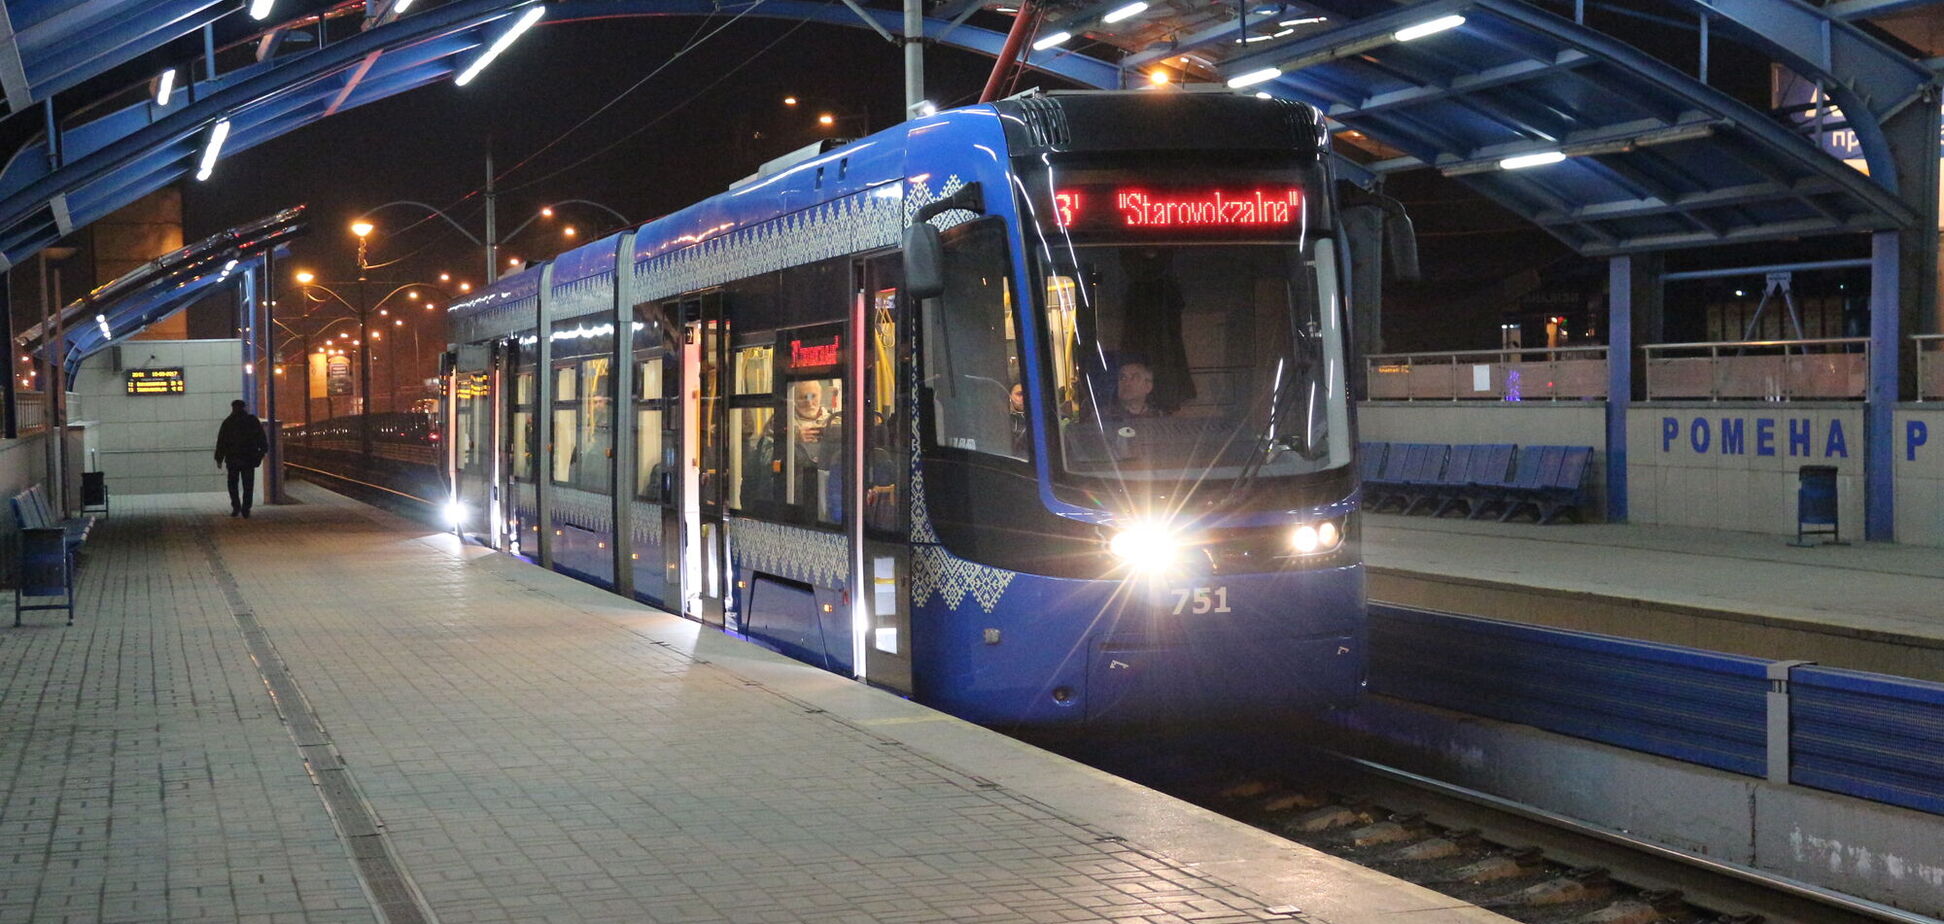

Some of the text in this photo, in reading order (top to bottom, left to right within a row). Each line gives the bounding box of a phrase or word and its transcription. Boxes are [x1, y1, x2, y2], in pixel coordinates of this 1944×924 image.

[1118, 190, 1299, 225] "Starovokzalna"
[1662, 416, 1849, 458] РОМЕНА
[1171, 586, 1232, 616] 751
